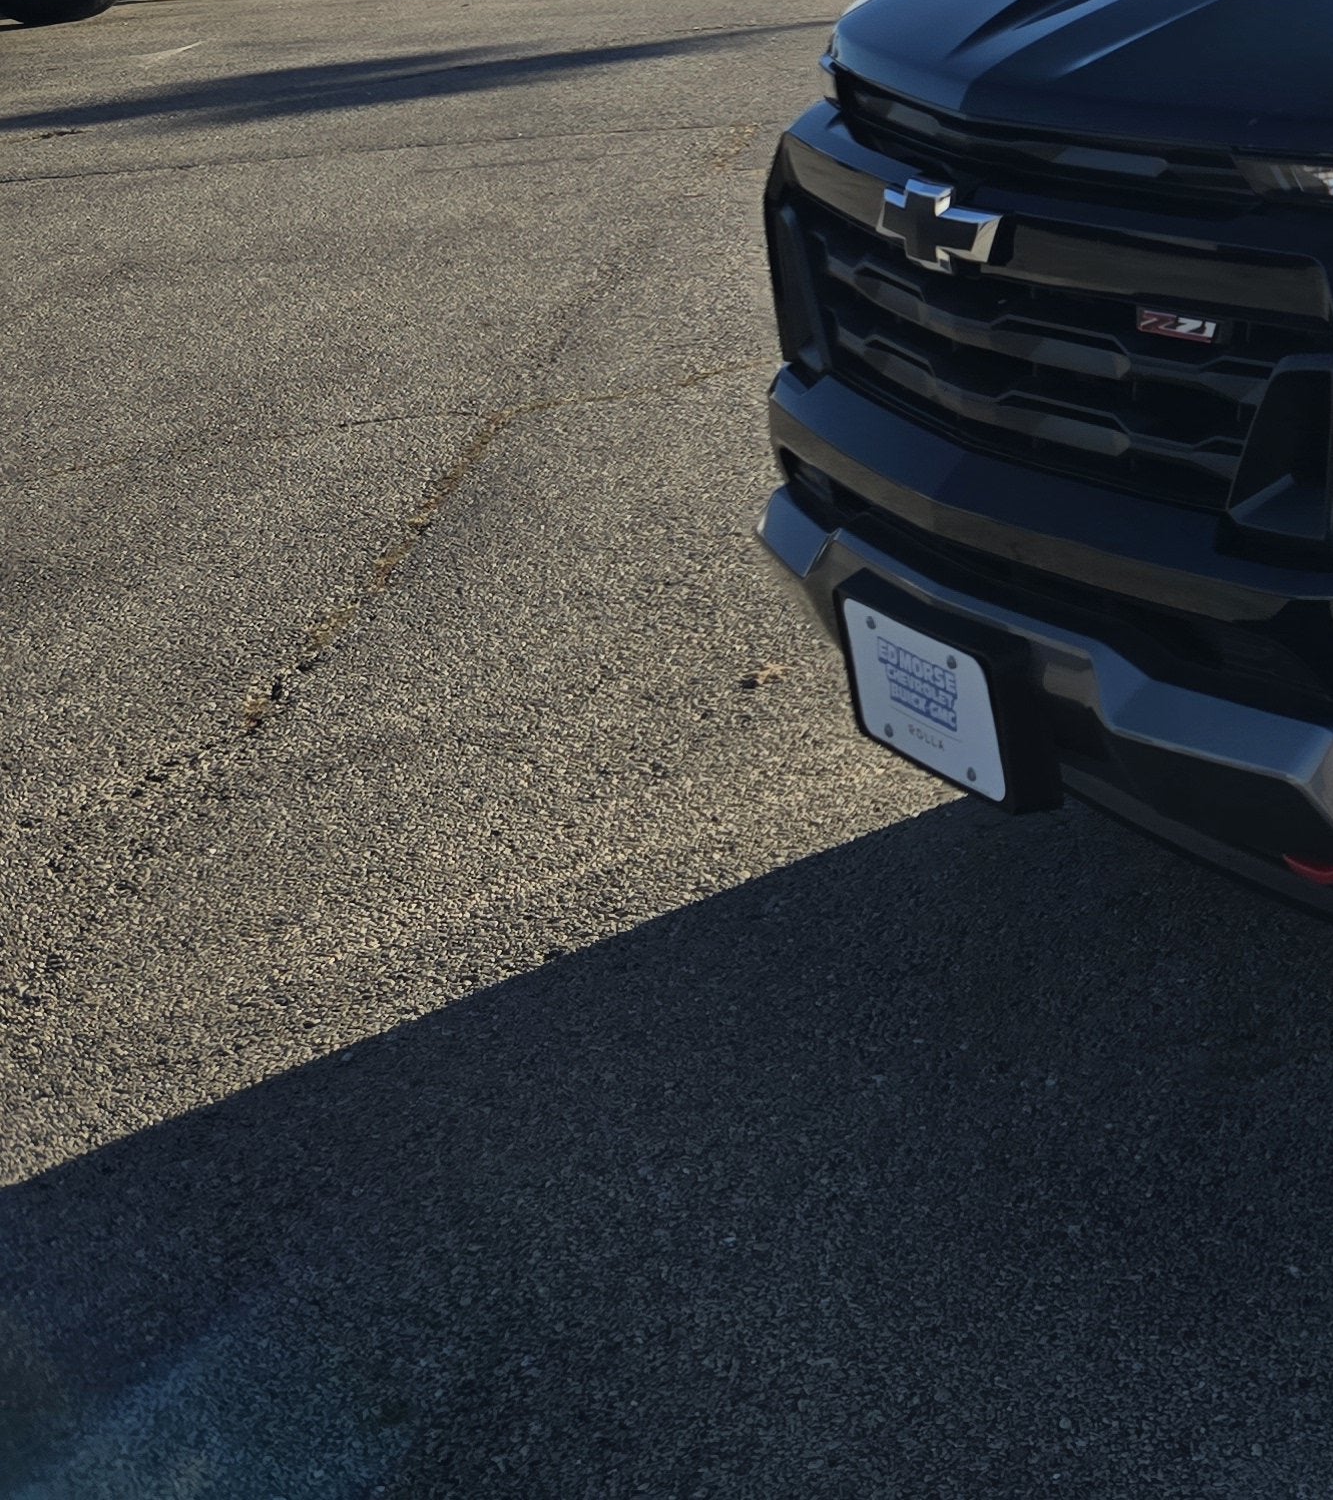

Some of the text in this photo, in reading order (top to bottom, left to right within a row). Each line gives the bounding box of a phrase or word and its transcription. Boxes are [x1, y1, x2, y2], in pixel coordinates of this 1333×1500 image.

[1138, 310, 1217, 344] Z71
[878, 637, 956, 696] ED MORSE
[886, 663, 954, 710] CHEVROLET
[908, 723, 945, 751] ROLLA
